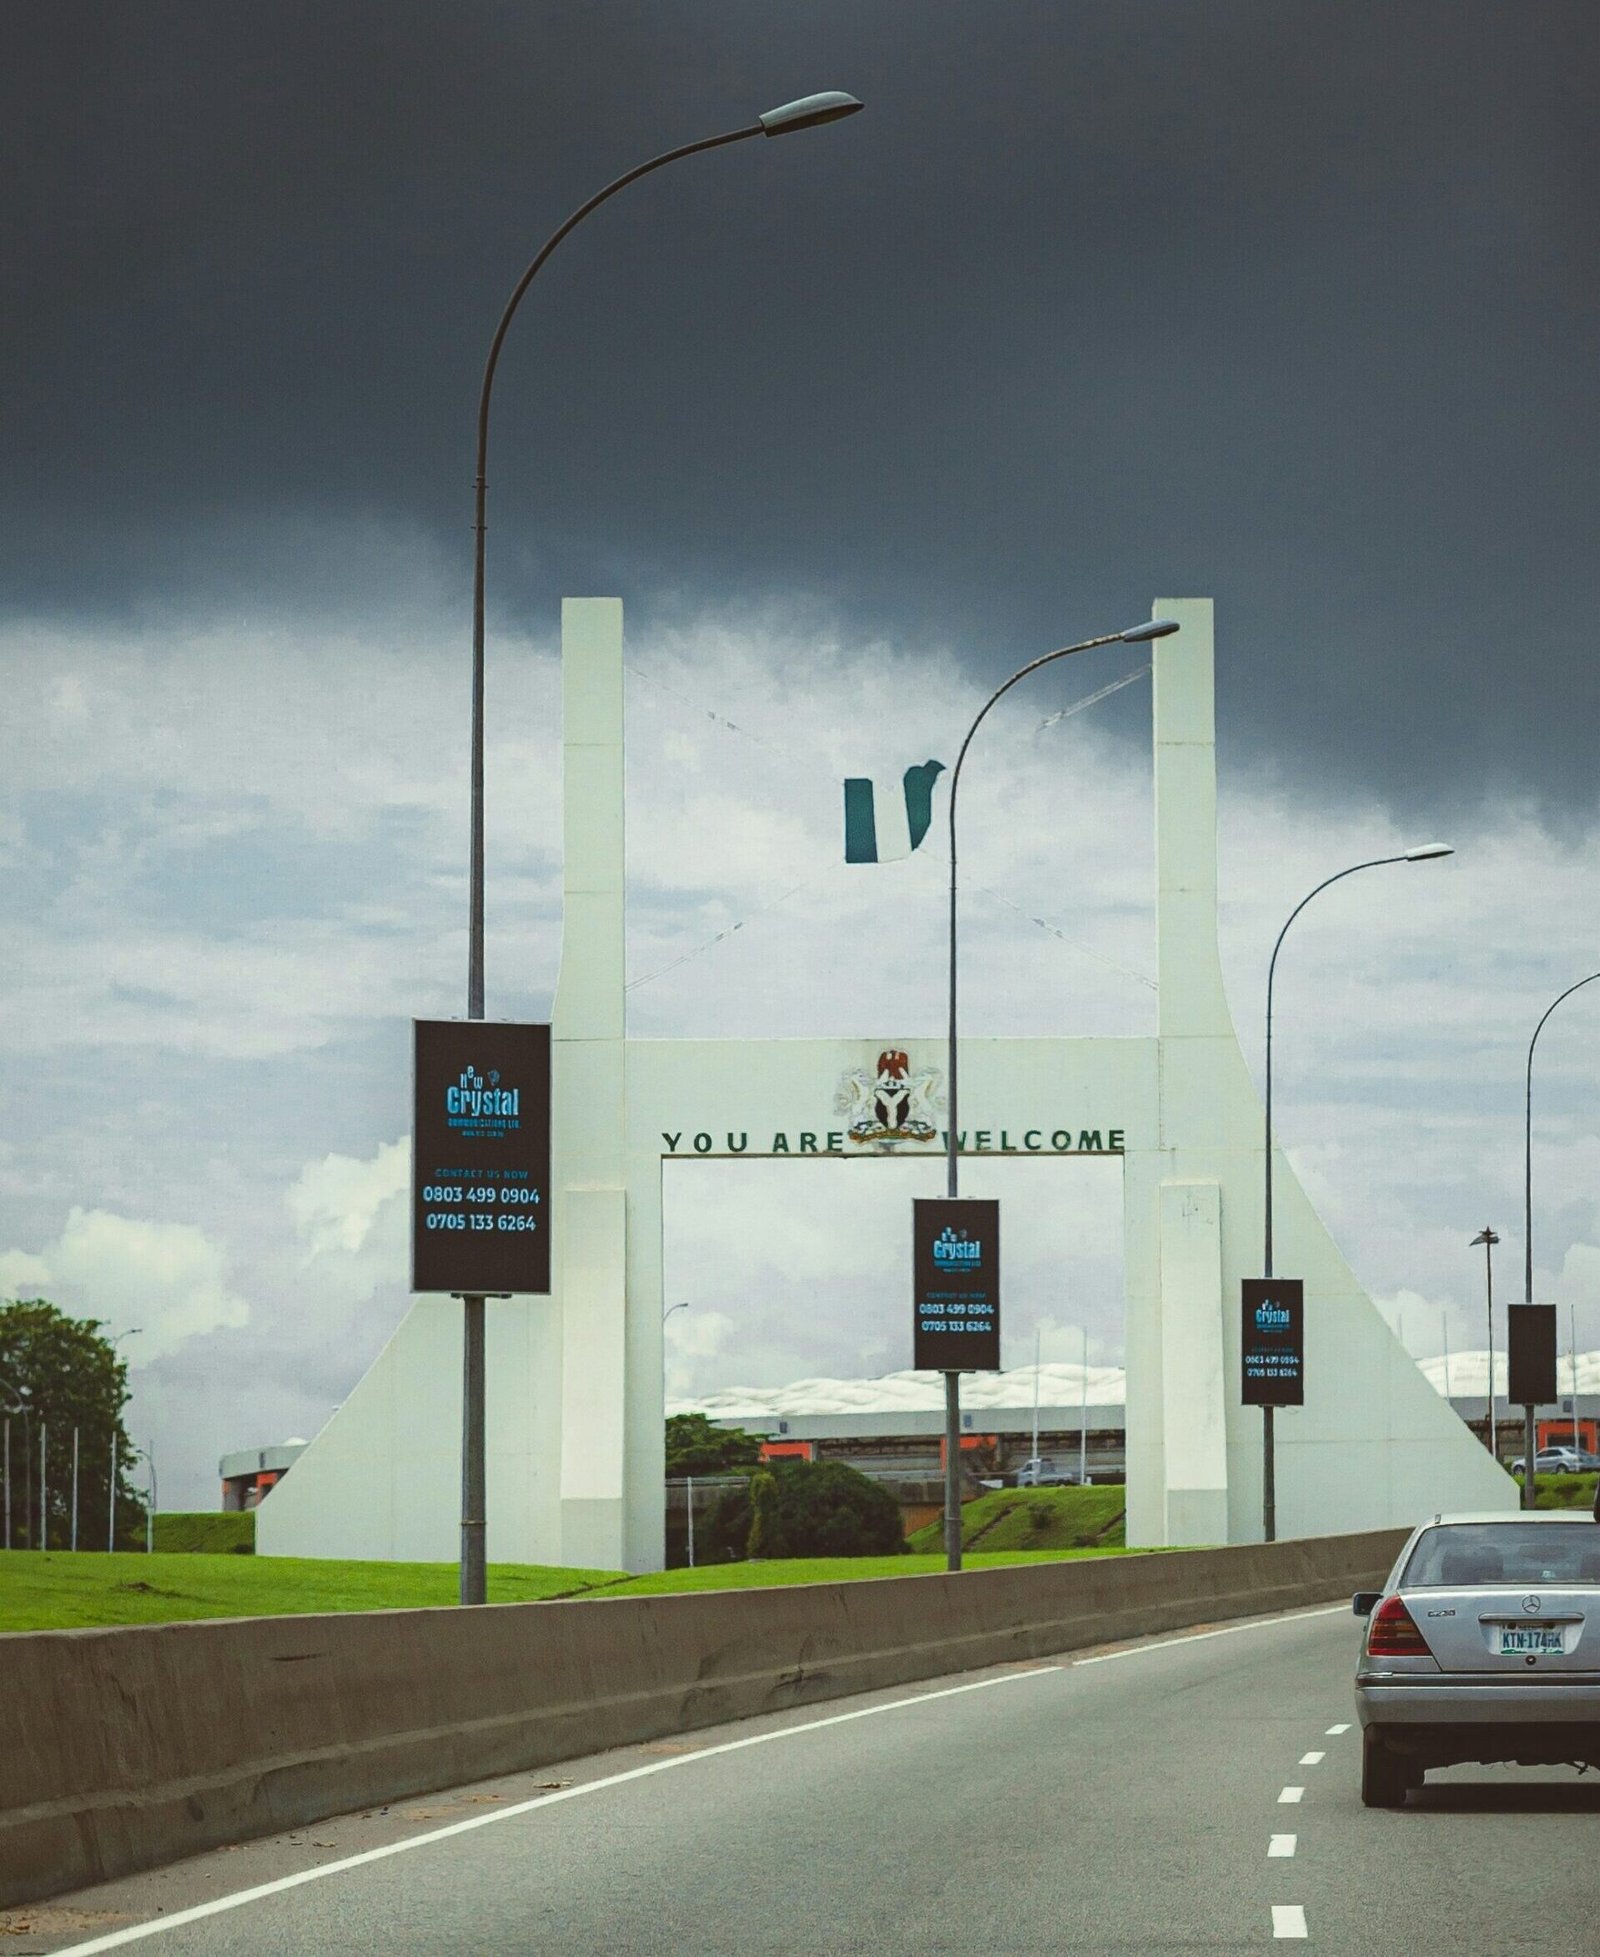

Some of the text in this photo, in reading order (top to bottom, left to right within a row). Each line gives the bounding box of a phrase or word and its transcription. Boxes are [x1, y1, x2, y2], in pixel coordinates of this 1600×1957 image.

[447, 1087, 519, 1116] Crystal
[662, 1130, 1125, 1152] YOU ARE WELCOME
[435, 1168, 528, 1180] CONTACT US NOW
[423, 1186, 540, 1204] 0803 499 0904
[426, 1213, 537, 1231] 0705 133 6264
[934, 1240, 981, 1260] Crystal
[1255, 1309, 1290, 1324] Crystal
